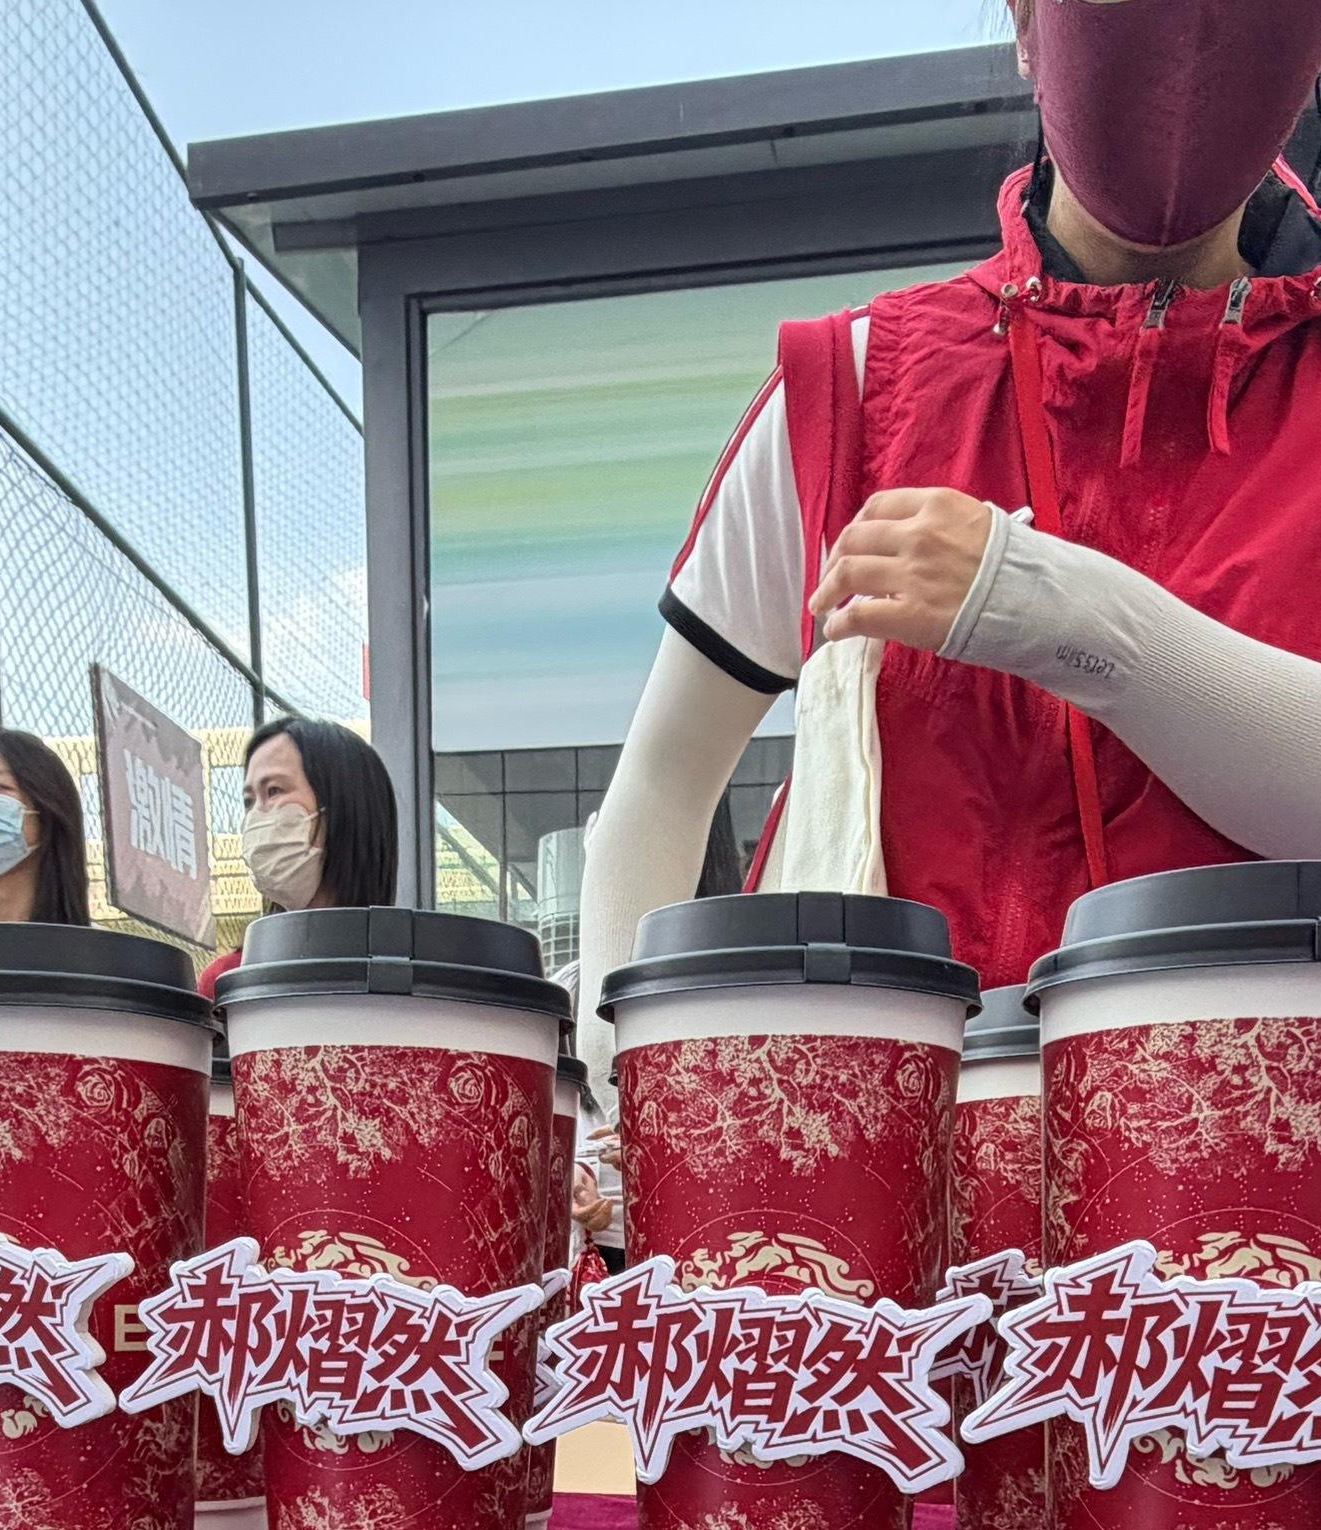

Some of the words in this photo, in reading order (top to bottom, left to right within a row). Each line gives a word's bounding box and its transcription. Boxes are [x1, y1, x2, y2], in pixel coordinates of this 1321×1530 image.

[165, 1270, 496, 1450] 郝熠然
[573, 1287, 933, 1476] 郝熠然
